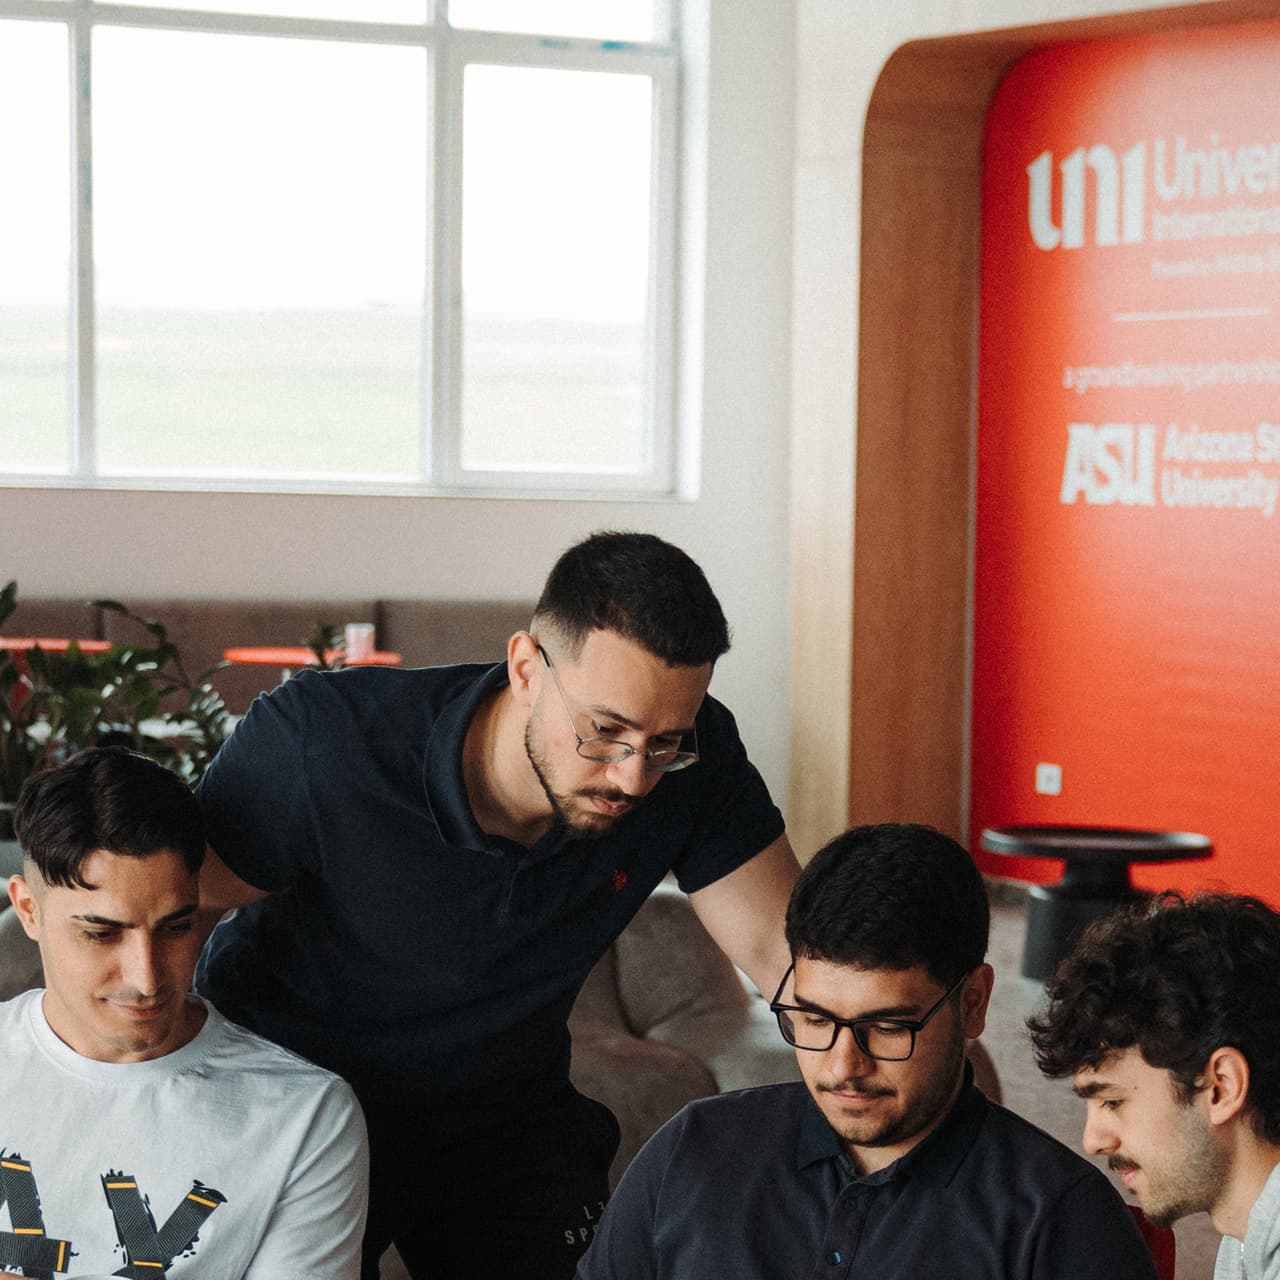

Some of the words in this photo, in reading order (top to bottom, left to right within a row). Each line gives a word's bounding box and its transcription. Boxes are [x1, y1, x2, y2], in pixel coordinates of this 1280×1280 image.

[1060, 422, 1156, 505] ASU
[1162, 423, 1254, 462] Arizona
[1161, 468, 1280, 518] University
